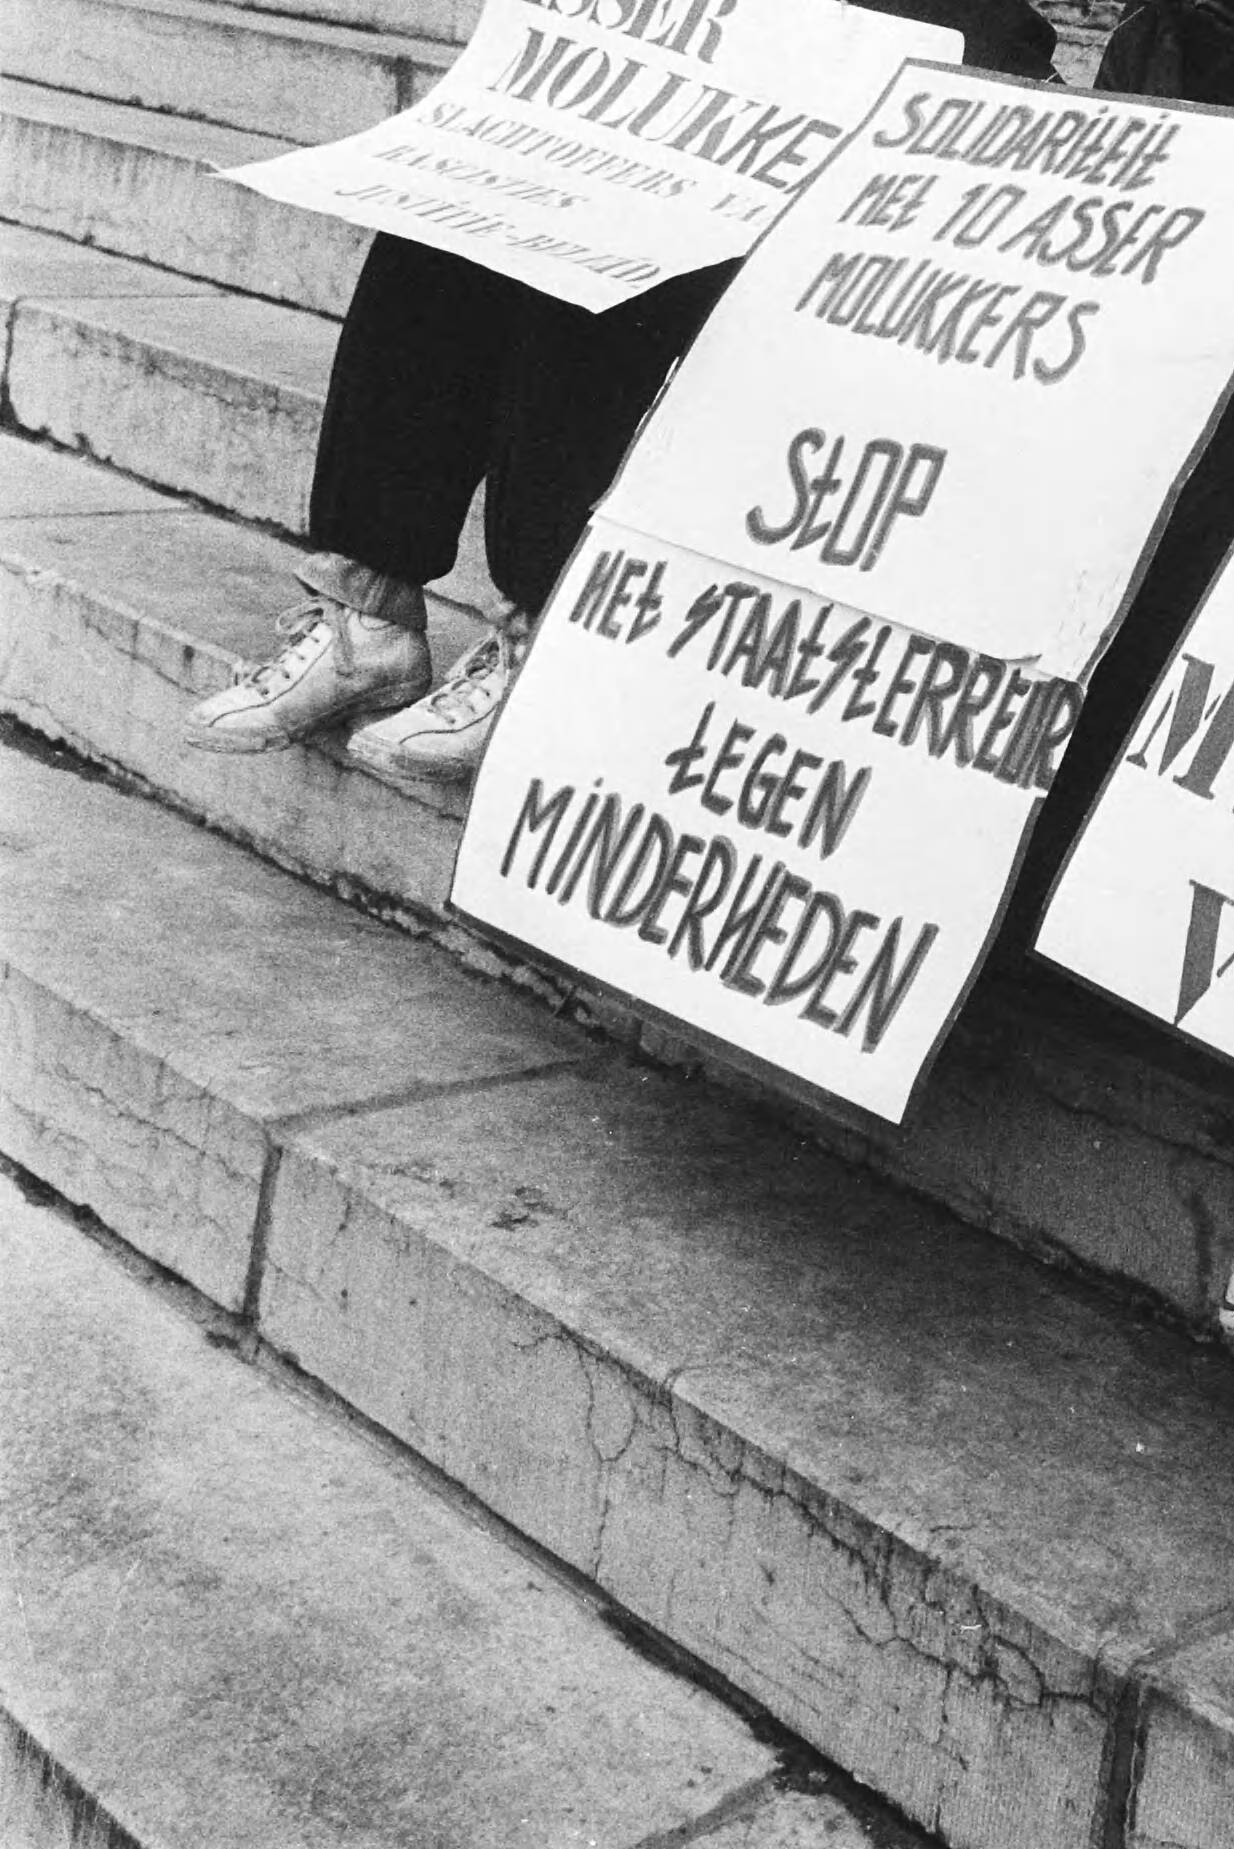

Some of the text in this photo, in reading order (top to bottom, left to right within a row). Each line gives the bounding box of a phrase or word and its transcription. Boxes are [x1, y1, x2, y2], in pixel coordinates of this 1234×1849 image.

[417, 102, 767, 225] SLACHTOFFERS VA
[933, 184, 1026, 247] 10
[1003, 195, 1206, 284] ASSER
[795, 253, 1100, 385] MOLUKKERS
[500, 778, 939, 1053] MINDERHEDEN
